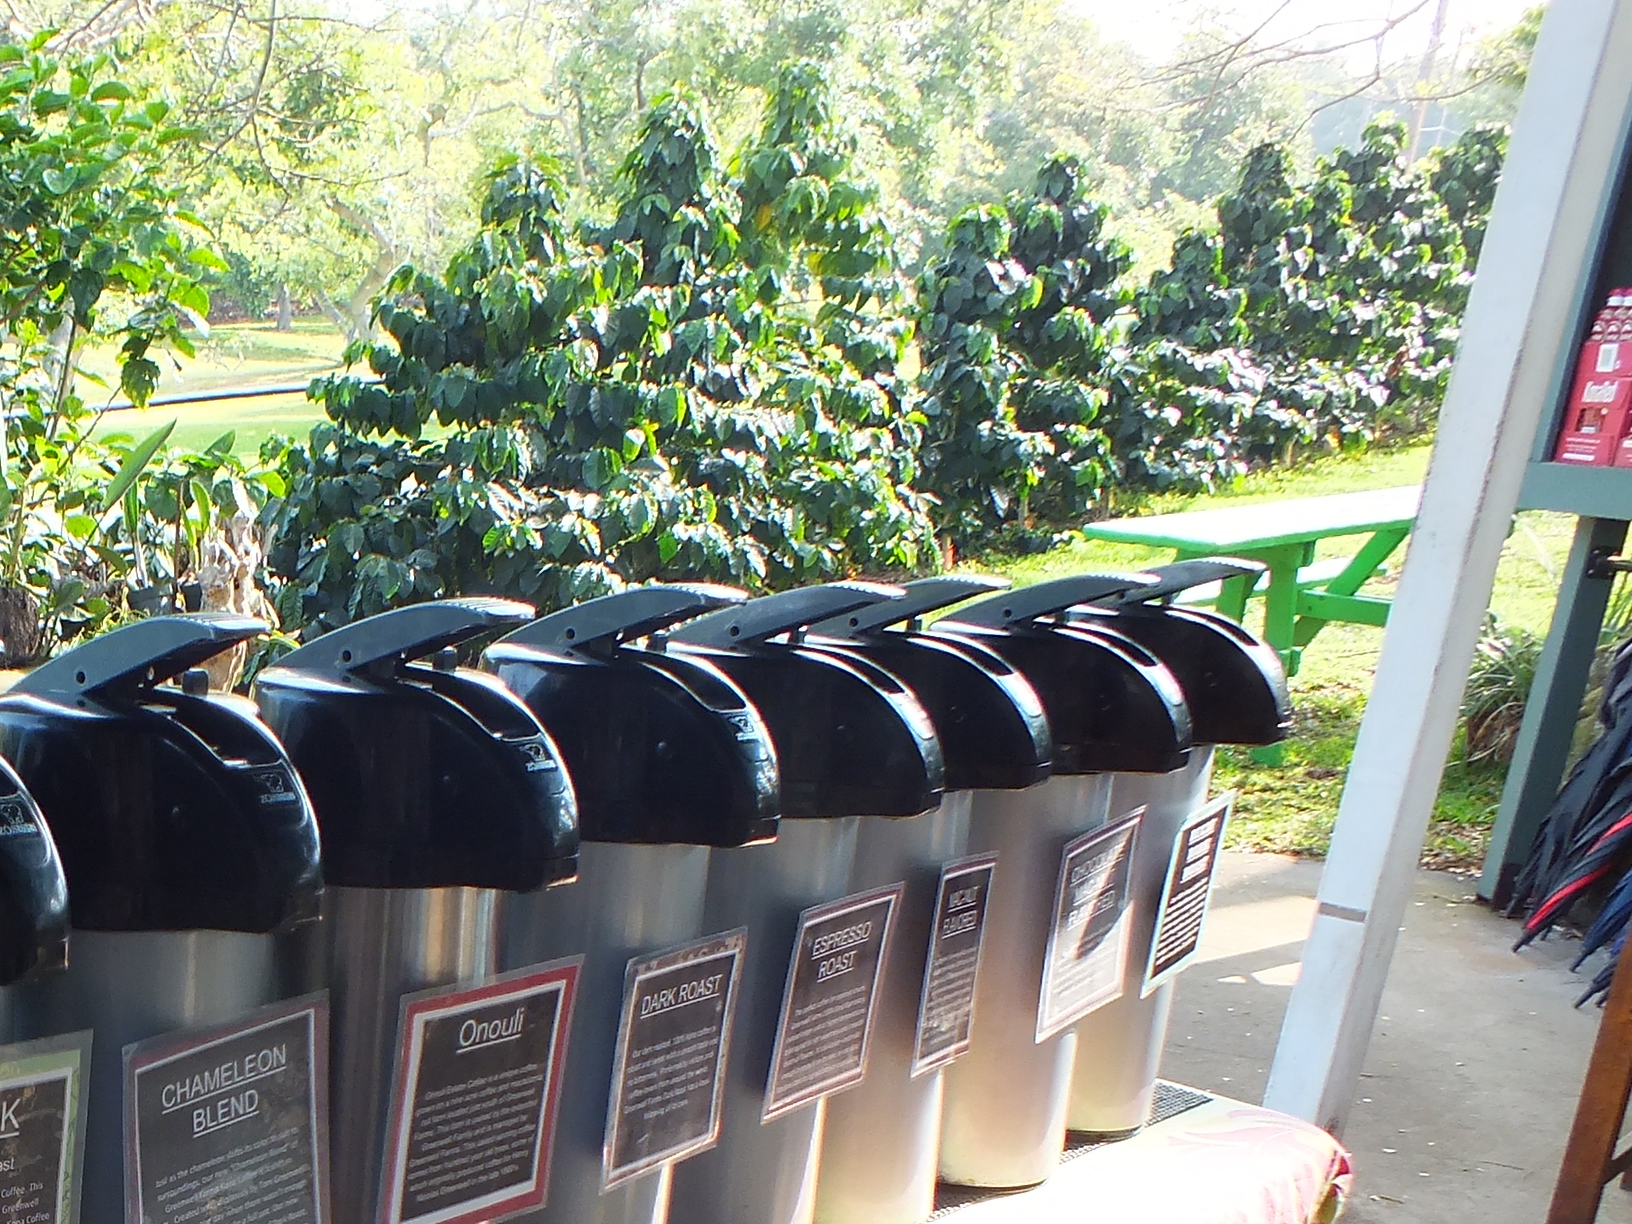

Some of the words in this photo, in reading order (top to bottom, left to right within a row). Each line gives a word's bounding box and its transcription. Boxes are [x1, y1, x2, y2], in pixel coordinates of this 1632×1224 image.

[812, 920, 872, 955] ESPRESSO
[818, 951, 857, 978] ROAST
[641, 988, 677, 1014] DARK
[678, 975, 722, 1003] ROAST
[458, 1008, 525, 1047] Onouli
[162, 1043, 286, 1109] CHAMELEON
[1, 1098, 21, 1131] K
[194, 1088, 259, 1132] BLEND
[26, 1214, 50, 1224] Coffee
